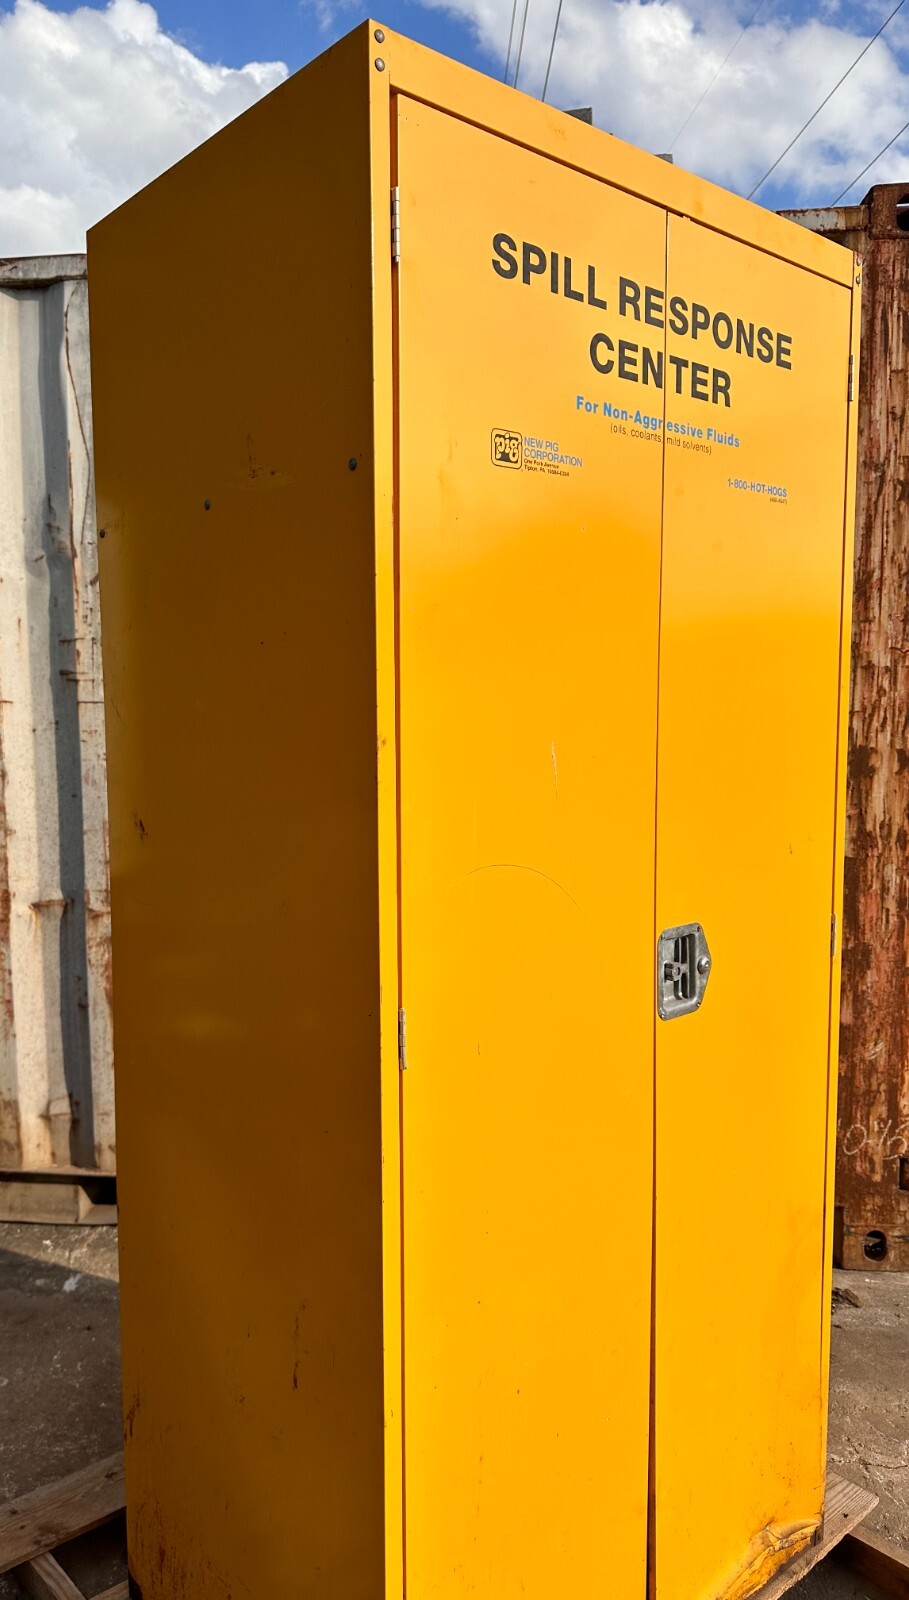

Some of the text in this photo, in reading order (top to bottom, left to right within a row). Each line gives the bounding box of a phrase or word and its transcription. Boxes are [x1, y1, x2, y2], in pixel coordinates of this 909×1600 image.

[491, 232, 793, 370] SPILL RESPONSE
[589, 332, 731, 408] CENTER
[576, 395, 740, 448] For Non-Aggressive Fluids
[494, 432, 520, 462] pig
[524, 437, 559, 452] NEW PIG
[610, 422, 629, 436] (oils,
[666, 436, 681, 447] mild
[682, 440, 712, 456] solvents)
[523, 447, 583, 467] CORPORATION
[727, 478, 787, 497] 1-800-HOT-HOGS
